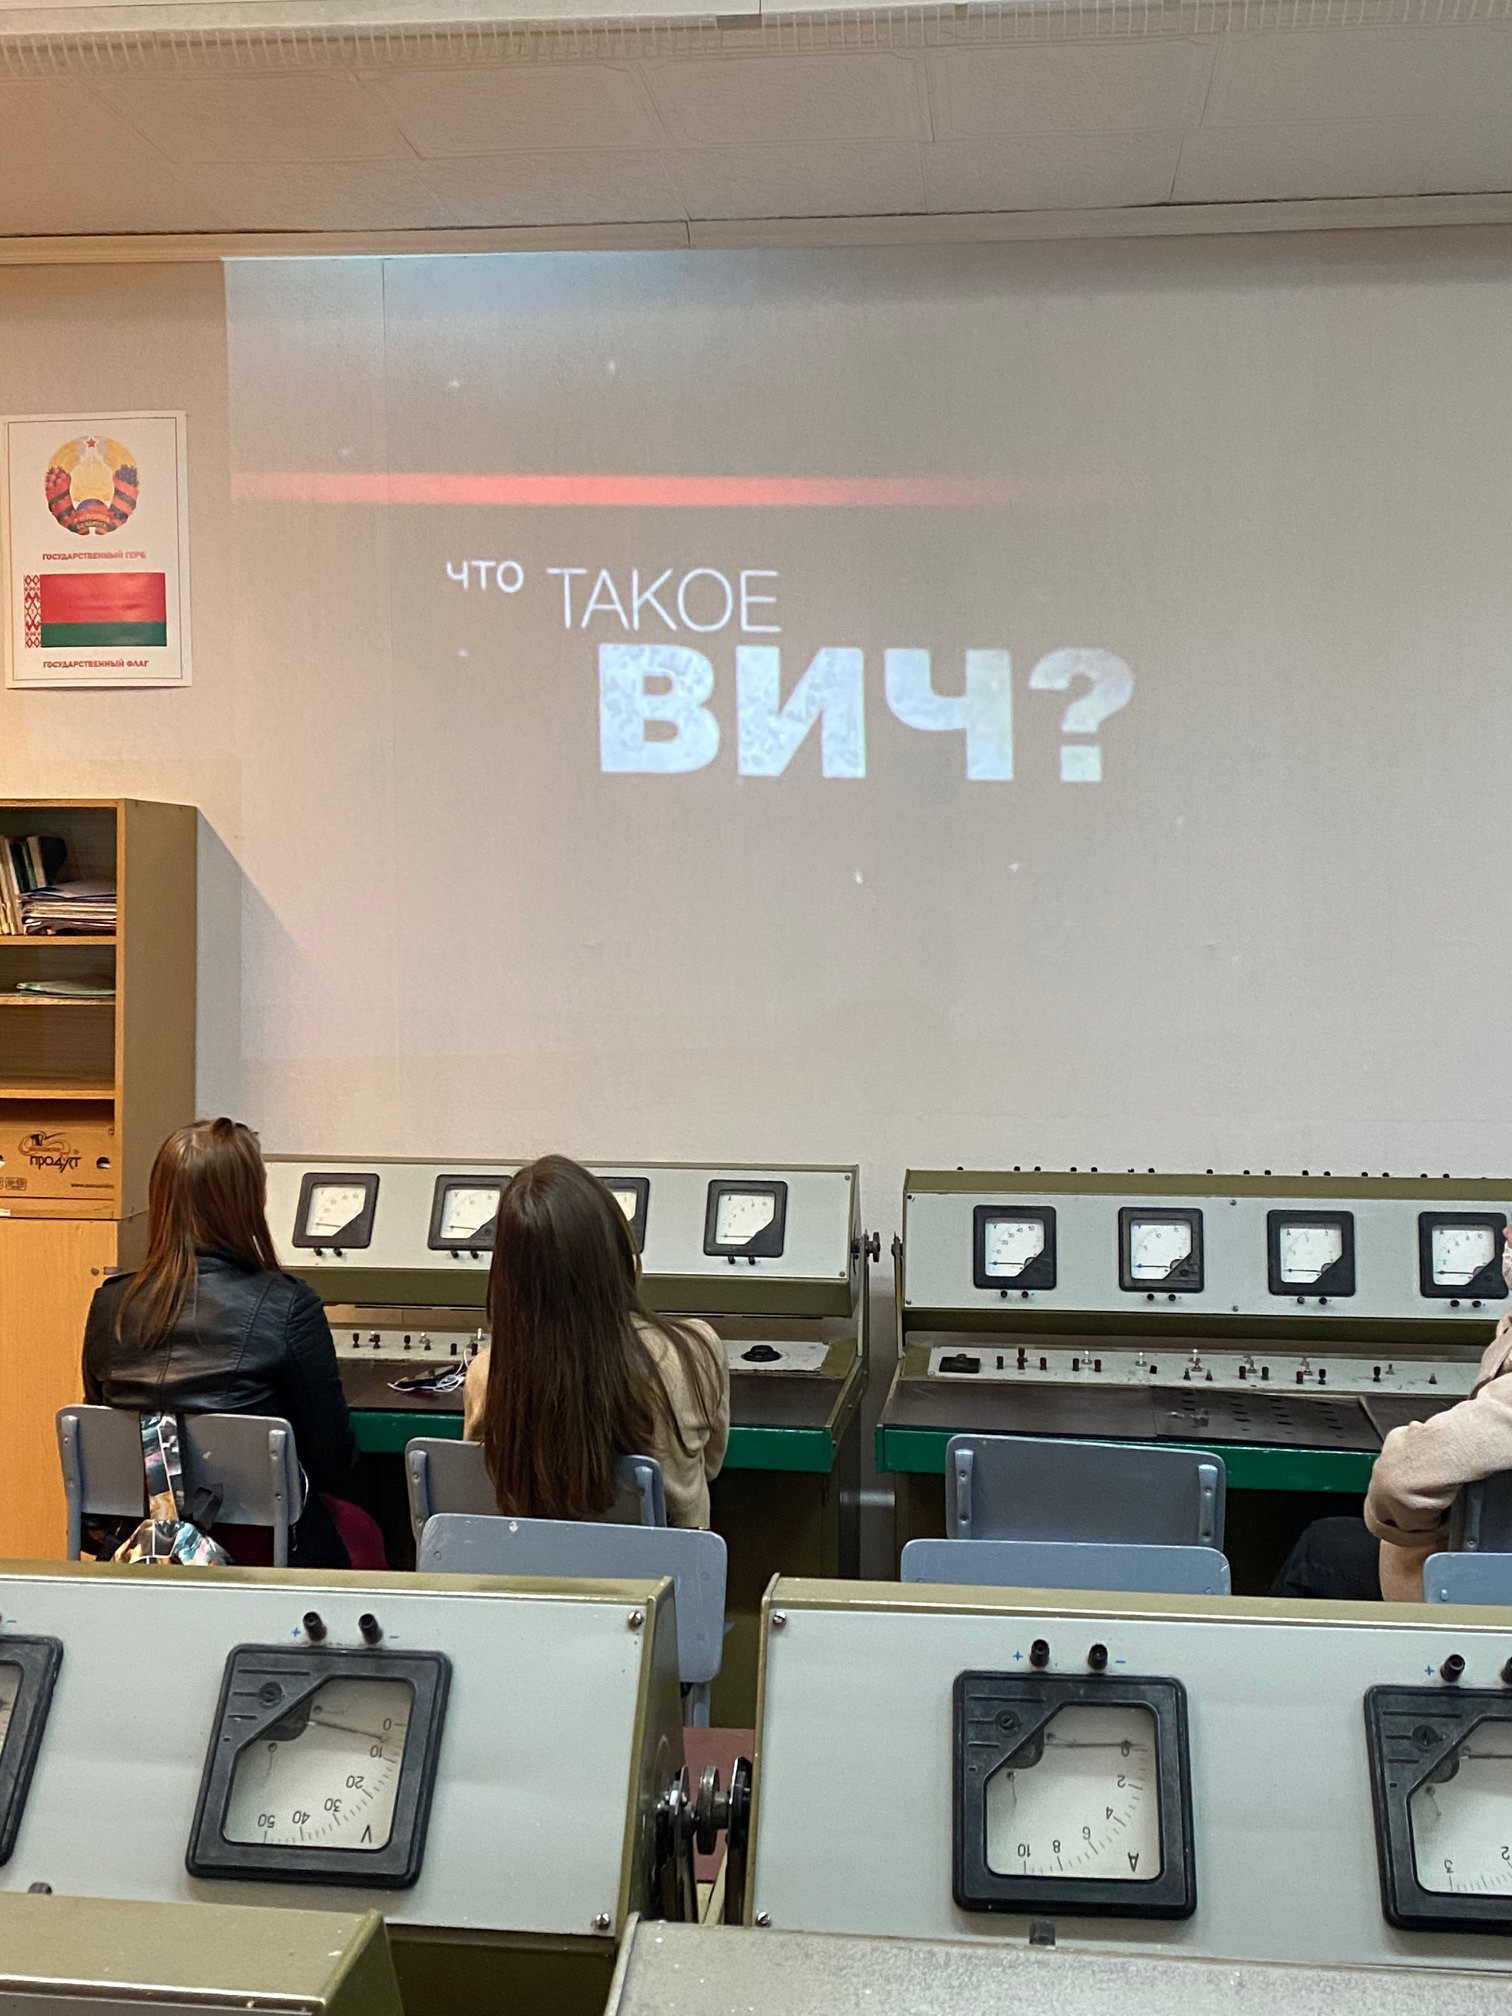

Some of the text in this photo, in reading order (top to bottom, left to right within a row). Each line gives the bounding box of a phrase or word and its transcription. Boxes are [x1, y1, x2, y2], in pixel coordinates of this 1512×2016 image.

[42, 551, 124, 560] ГОСУДАРСТВЕННЫЙ
[546, 568, 782, 633] ТАКОЕ
[43, 659, 148, 668] ГОСУДАРСТВЕННЫЙ ФЛАГ
[599, 643, 1135, 783] ВИЧ?
[383, 1718, 391, 1731] 0
[370, 1745, 383, 1758] 10
[346, 1775, 365, 1789] 20
[1117, 1774, 1126, 1788] 2
[324, 1798, 342, 1812] 30
[292, 1810, 310, 1825] 40
[1106, 1806, 1113, 1820] 4
[257, 1814, 275, 1828] 50
[360, 1824, 372, 1844] V
[1082, 1826, 1091, 1840] 6
[1017, 1843, 1031, 1858] 10
[1052, 1839, 1061, 1854] 8
[1501, 1846, 1511, 1861] 2
[1127, 1852, 1139, 1872] A
[1444, 1859, 1453, 1874] 3
